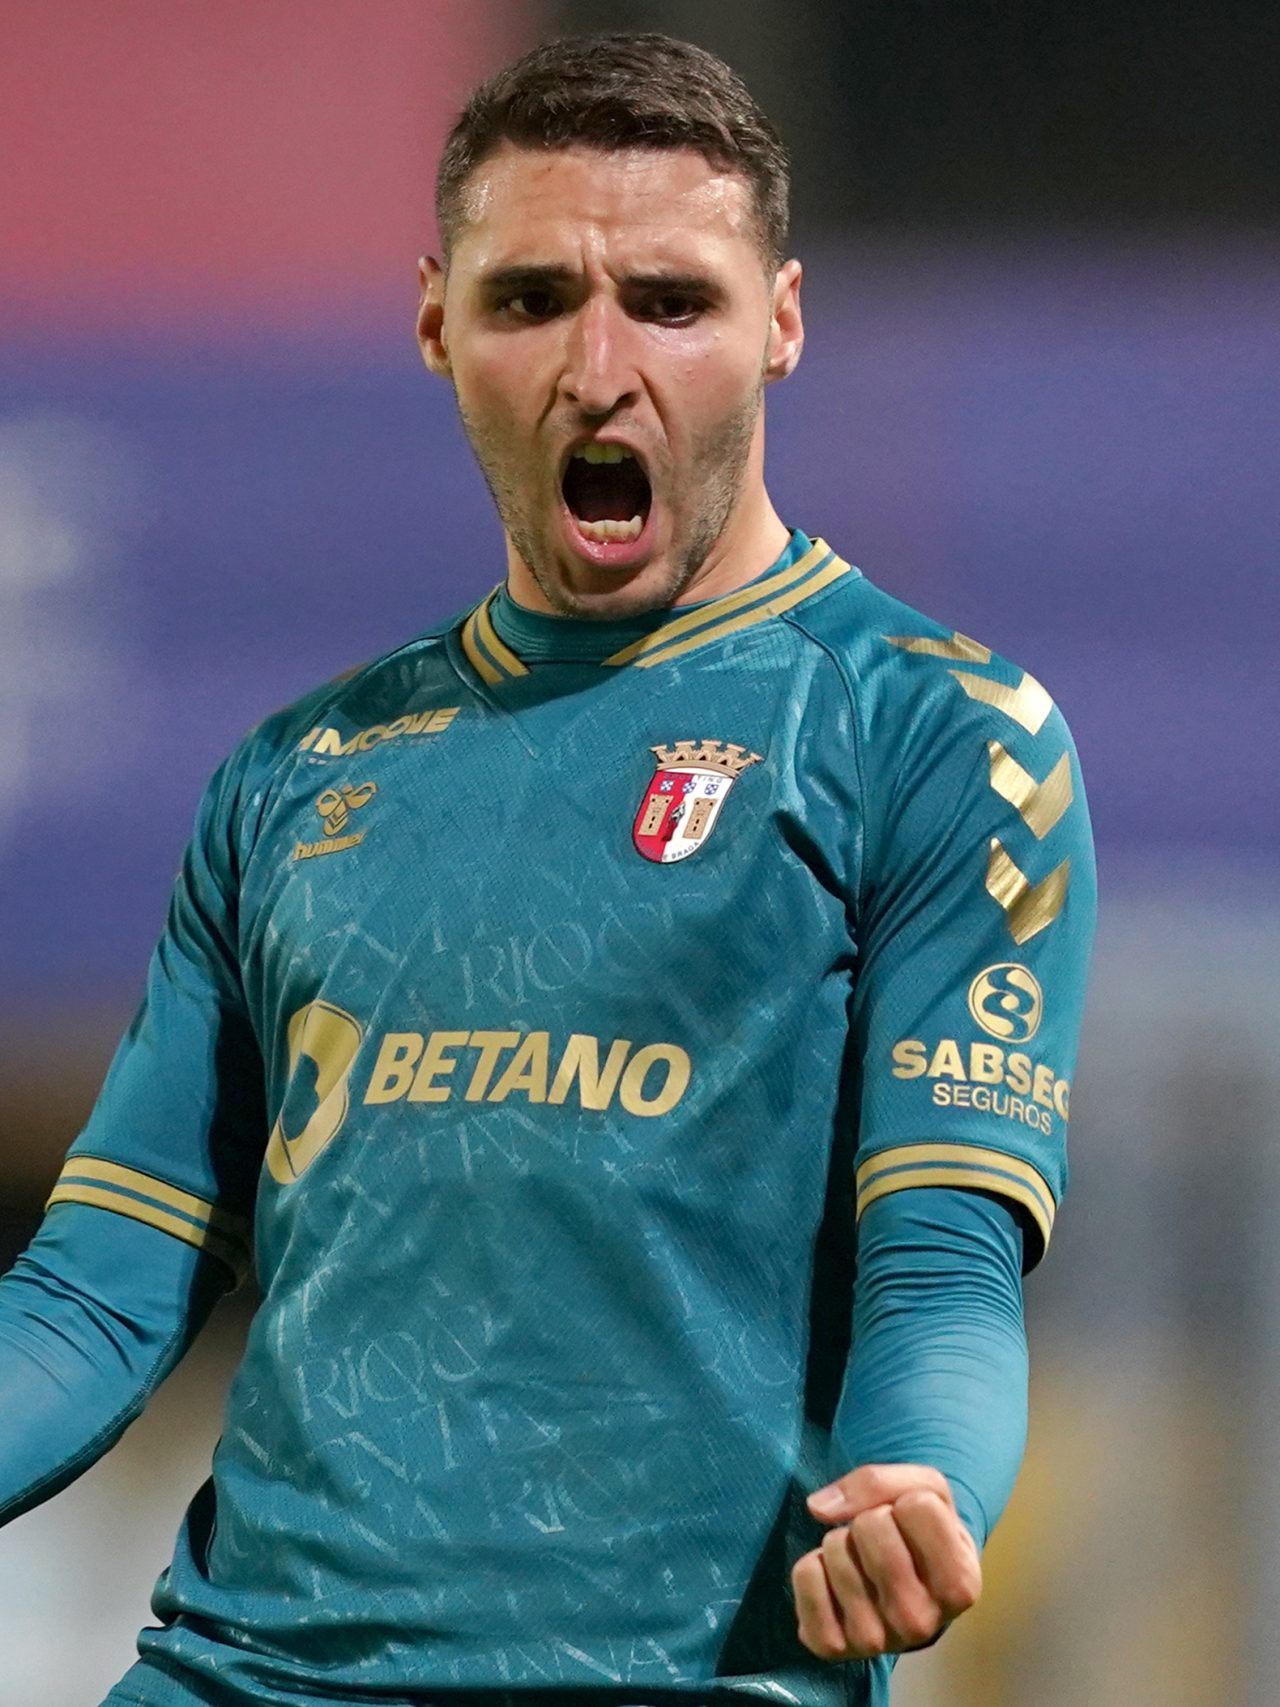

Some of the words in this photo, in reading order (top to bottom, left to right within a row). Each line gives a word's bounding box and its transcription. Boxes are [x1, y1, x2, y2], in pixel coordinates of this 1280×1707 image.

[671, 841, 700, 860] BRAGA
[363, 1030, 691, 1118] BETANO
[932, 1082, 1052, 1136] SEGUROS
